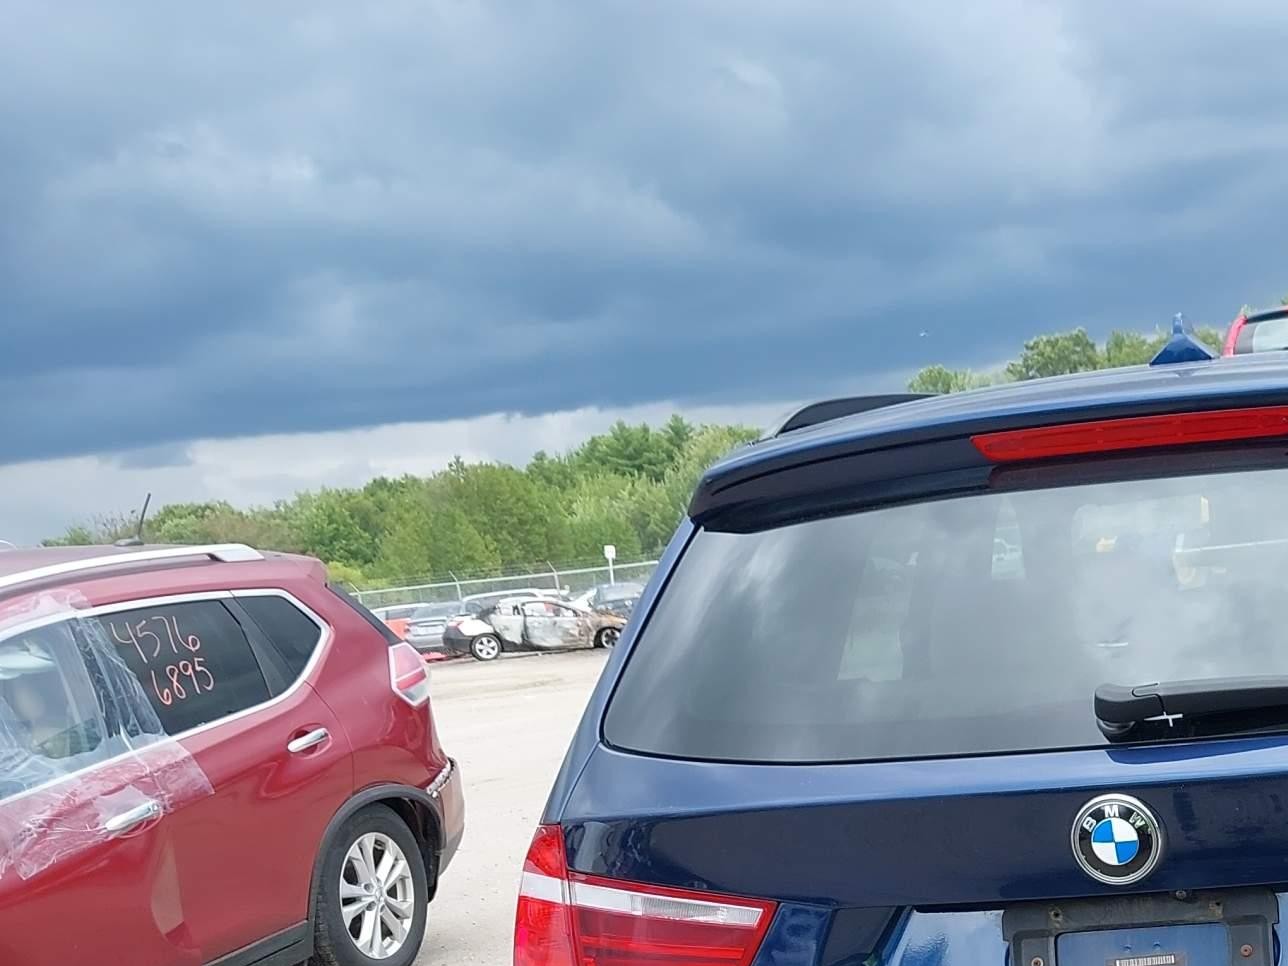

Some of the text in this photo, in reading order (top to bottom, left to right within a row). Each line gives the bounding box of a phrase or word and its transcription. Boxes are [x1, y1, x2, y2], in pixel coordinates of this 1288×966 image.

[109, 615, 201, 664] 4576
[150, 657, 214, 705] 6895
[1082, 804, 1146, 832] BMW
